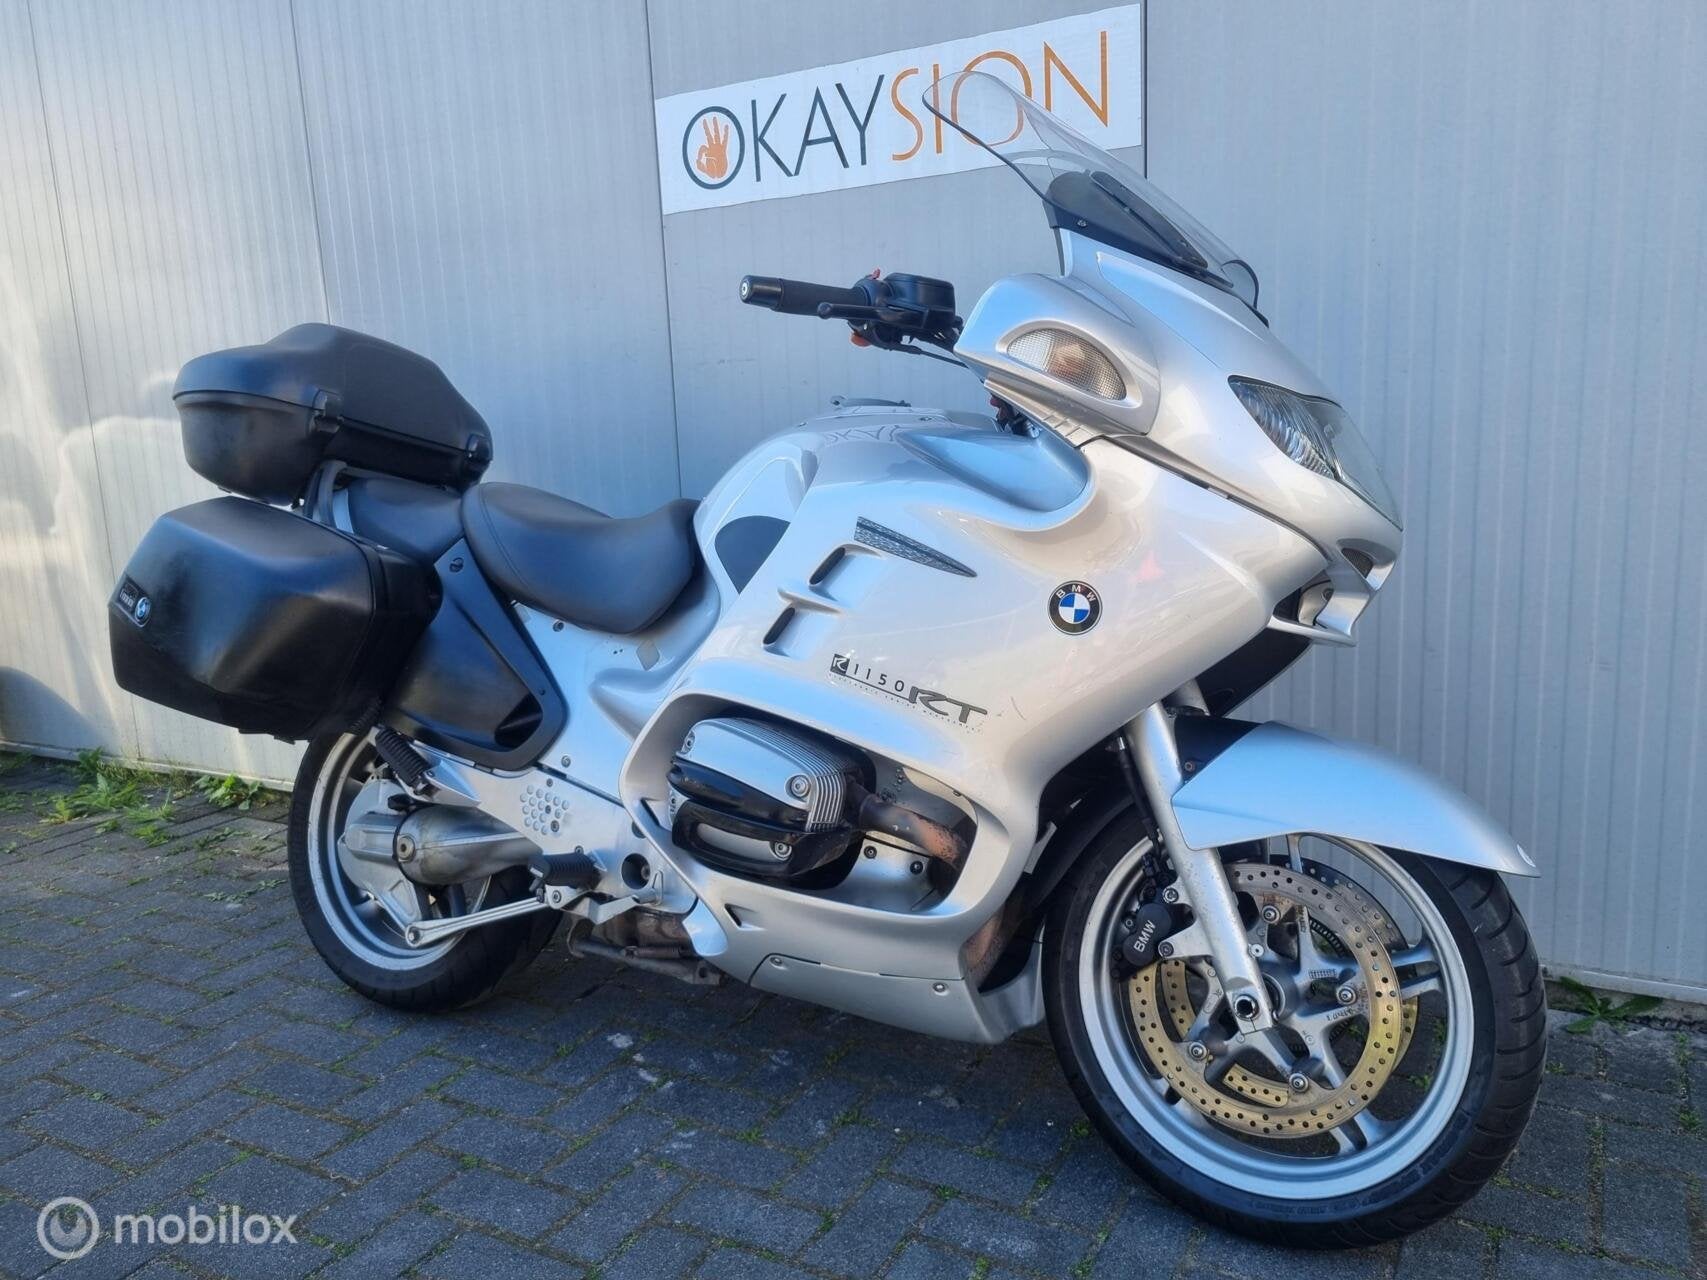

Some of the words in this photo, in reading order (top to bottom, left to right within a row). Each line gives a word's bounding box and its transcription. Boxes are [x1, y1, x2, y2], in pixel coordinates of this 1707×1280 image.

[682, 31, 1109, 190] OKAYSION
[1055, 584, 1097, 602] BMW
[854, 663, 905, 693] 1150
[1133, 919, 1156, 953] BMW
